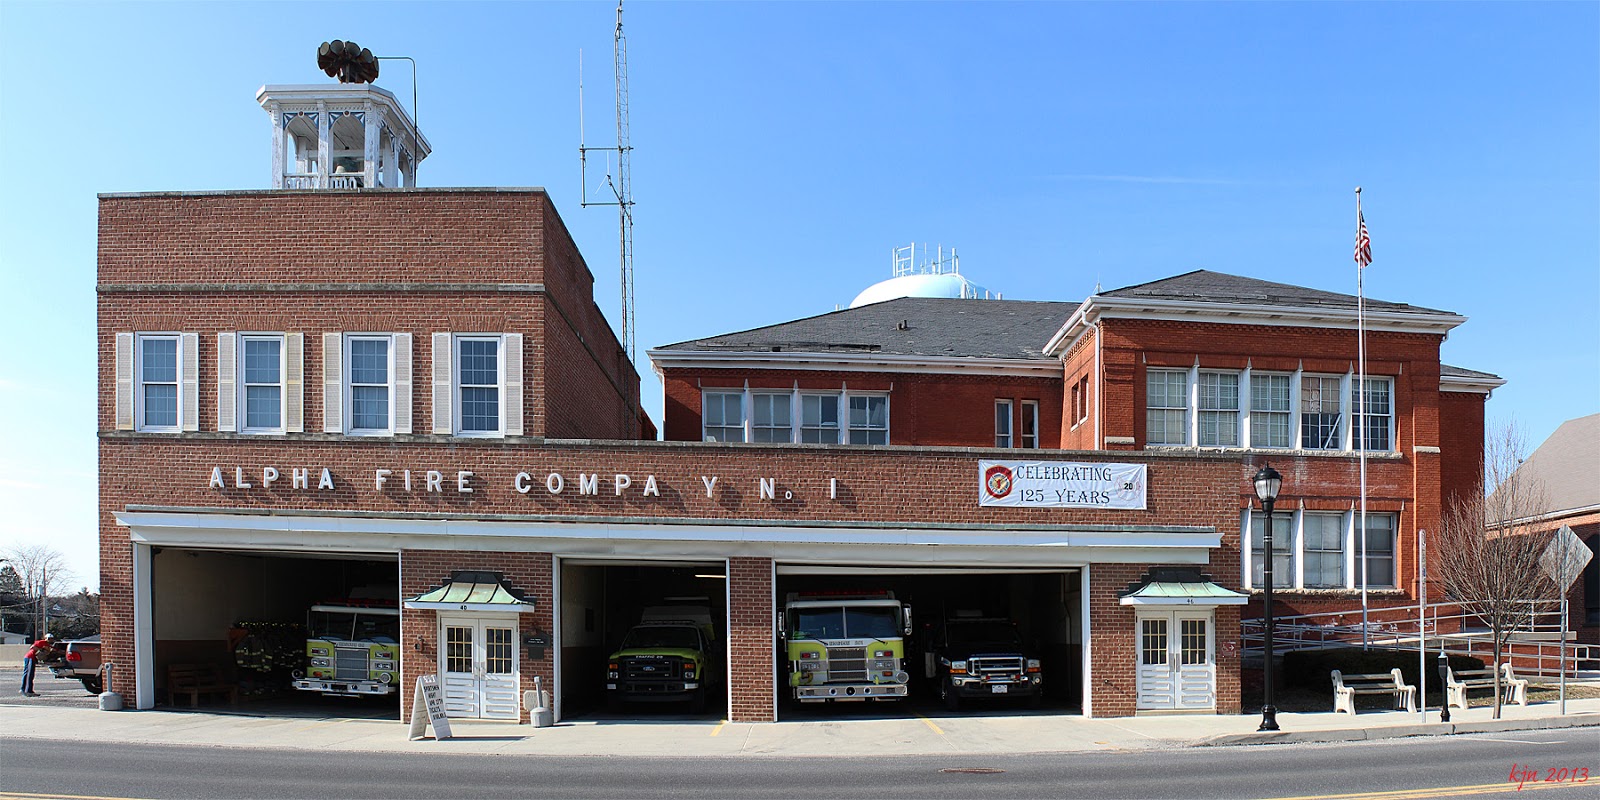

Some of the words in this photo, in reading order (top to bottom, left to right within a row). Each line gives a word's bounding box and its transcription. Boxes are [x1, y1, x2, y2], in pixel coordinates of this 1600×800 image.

[209, 466, 335, 490] ALPHA
[375, 469, 474, 493] FIRE
[1016, 465, 1112, 481] CELEBRATING
[1123, 482, 1133, 490] 20
[1019, 489, 1044, 502] 125
[1055, 489, 1111, 504] YEARS
